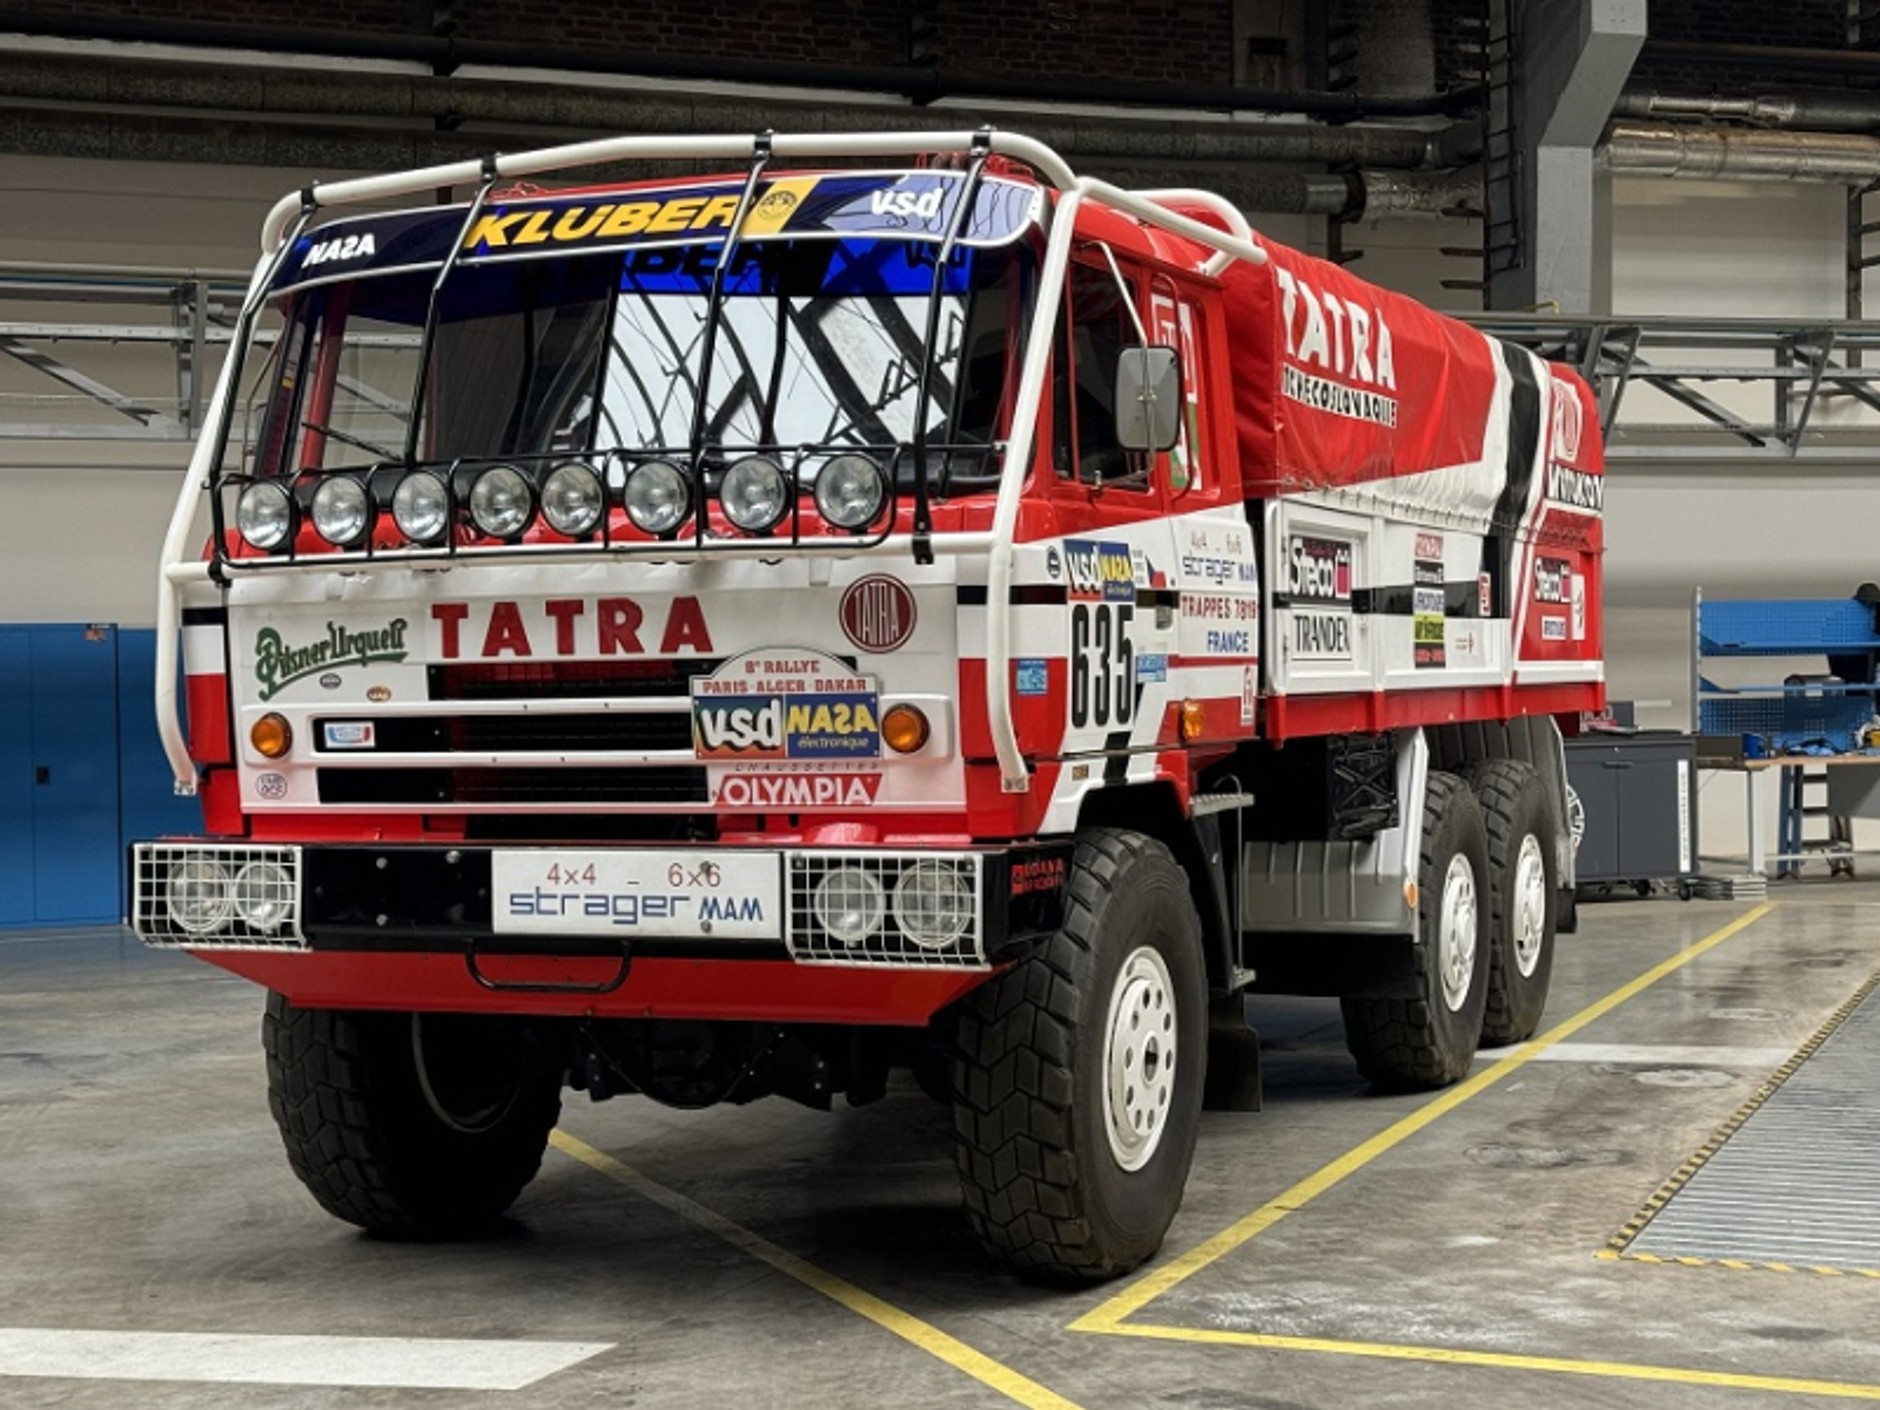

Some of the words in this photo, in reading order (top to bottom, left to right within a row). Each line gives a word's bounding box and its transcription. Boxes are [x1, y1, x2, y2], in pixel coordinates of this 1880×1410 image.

[463, 195, 741, 248] KLUBER
[871, 188, 943, 217] vsd
[1275, 265, 1397, 391] TATRA
[855, 583, 900, 645] TATRA
[1182, 596, 1230, 618] TRAPPES
[432, 596, 713, 658] TATRA
[1208, 630, 1249, 652] FRANCE
[256, 627, 331, 701] Pilsner
[327, 618, 408, 667] Urquell
[764, 660, 820, 673] RALLYE
[1072, 604, 1134, 729] 635
[815, 679, 866, 692] DAKAR
[702, 699, 781, 747] vsd
[724, 777, 872, 805] OLYMPIA
[547, 863, 597, 885] 4x4
[668, 862, 721, 887] 6x6
[510, 886, 690, 925] strager
